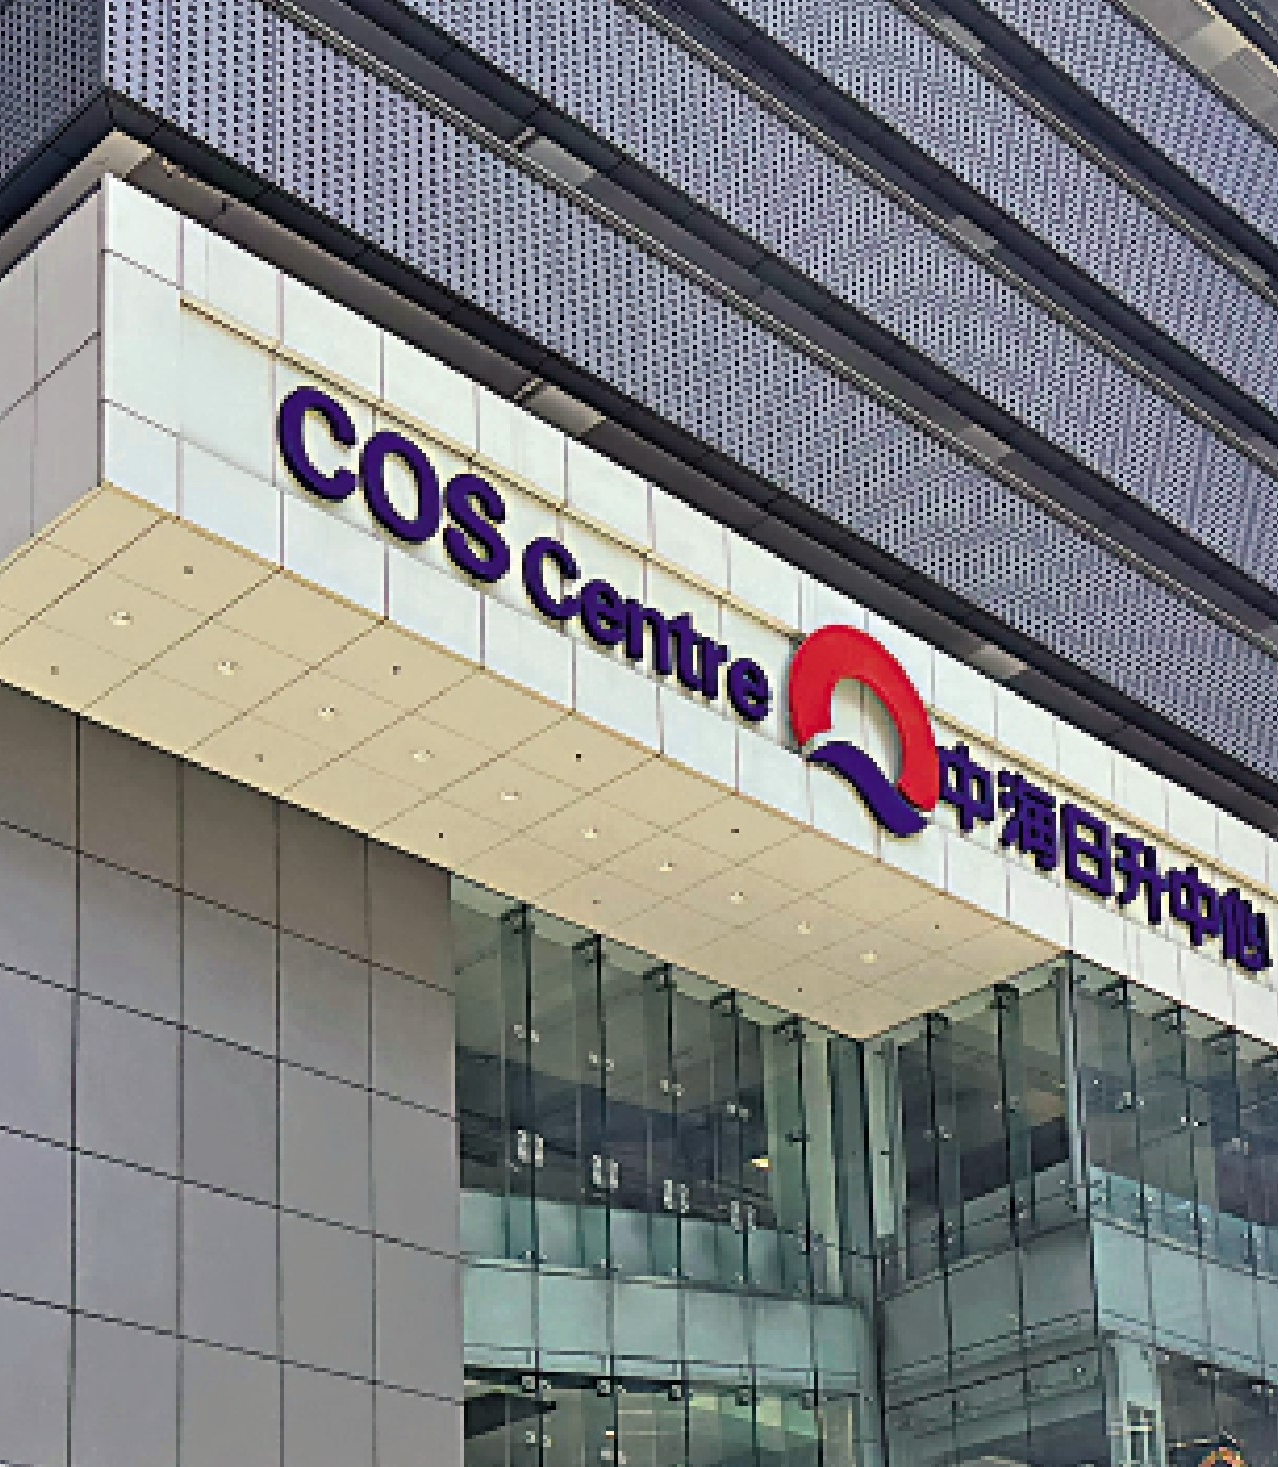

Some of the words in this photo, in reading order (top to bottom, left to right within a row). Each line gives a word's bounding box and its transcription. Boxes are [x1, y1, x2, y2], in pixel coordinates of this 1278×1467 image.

[279, 386, 511, 585] COS
[523, 538, 771, 723] Centre
[939, 745, 1272, 970] 中海日升中心
